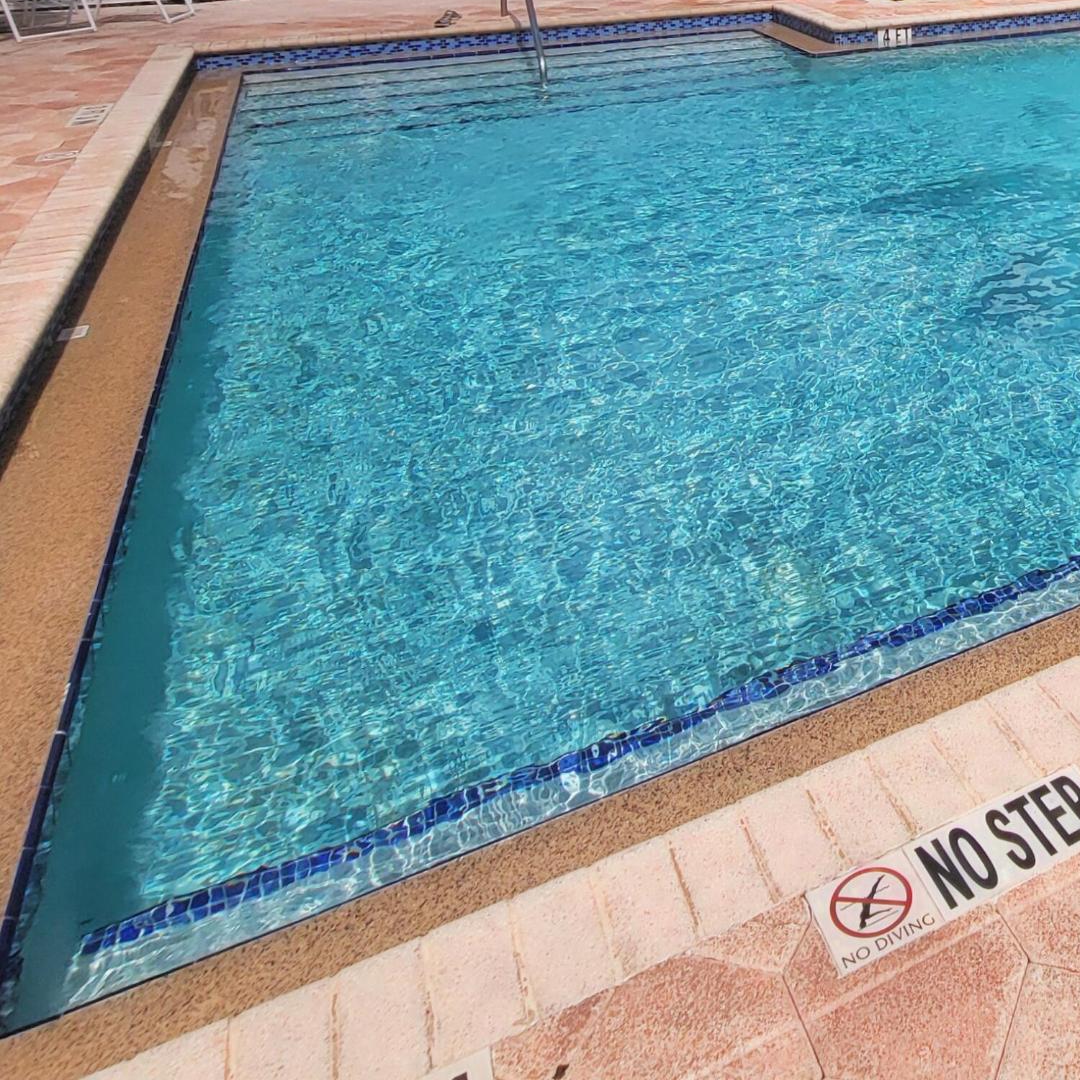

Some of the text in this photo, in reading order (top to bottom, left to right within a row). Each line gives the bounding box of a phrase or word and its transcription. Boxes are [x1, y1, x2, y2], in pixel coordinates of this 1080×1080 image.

[914, 827, 998, 910] NO
[841, 913, 936, 969] NO DIVING
